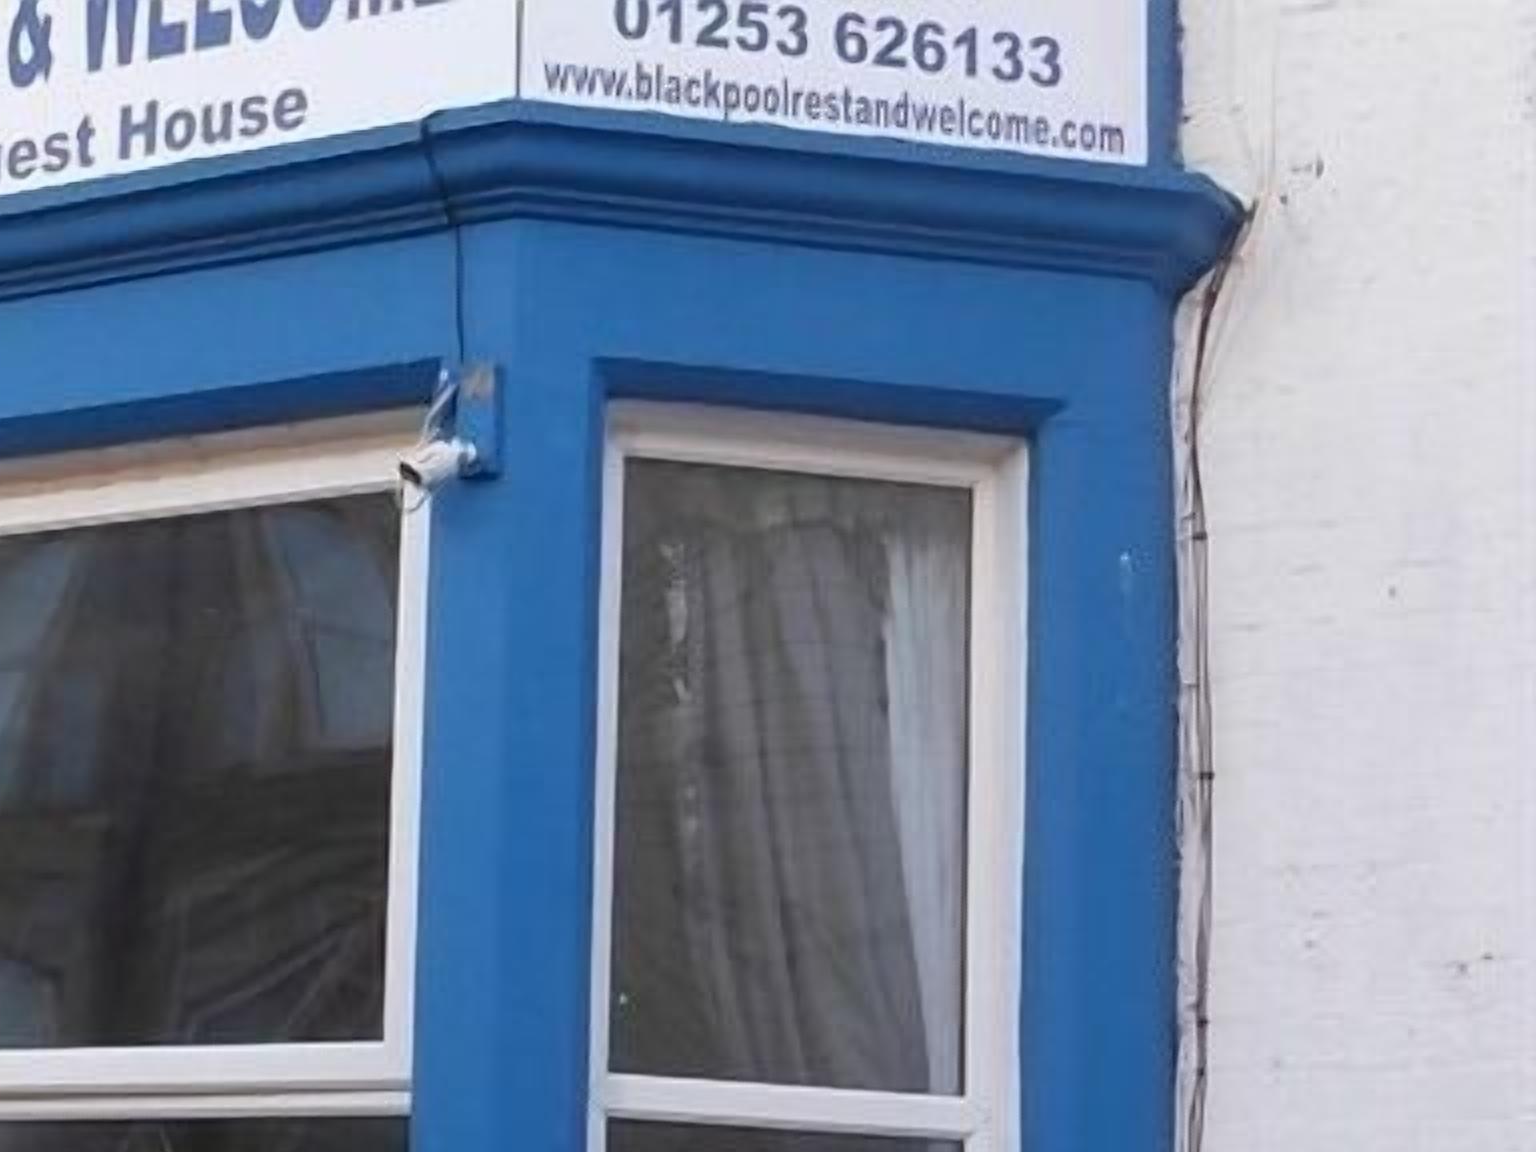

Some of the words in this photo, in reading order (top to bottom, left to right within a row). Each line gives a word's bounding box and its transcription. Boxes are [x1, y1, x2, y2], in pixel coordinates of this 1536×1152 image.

[615, 0, 808, 57] 01253
[834, 12, 1061, 87] 626133
[116, 86, 309, 161] House
[544, 61, 1125, 154] www.blackpoolrestandwelcome.com
